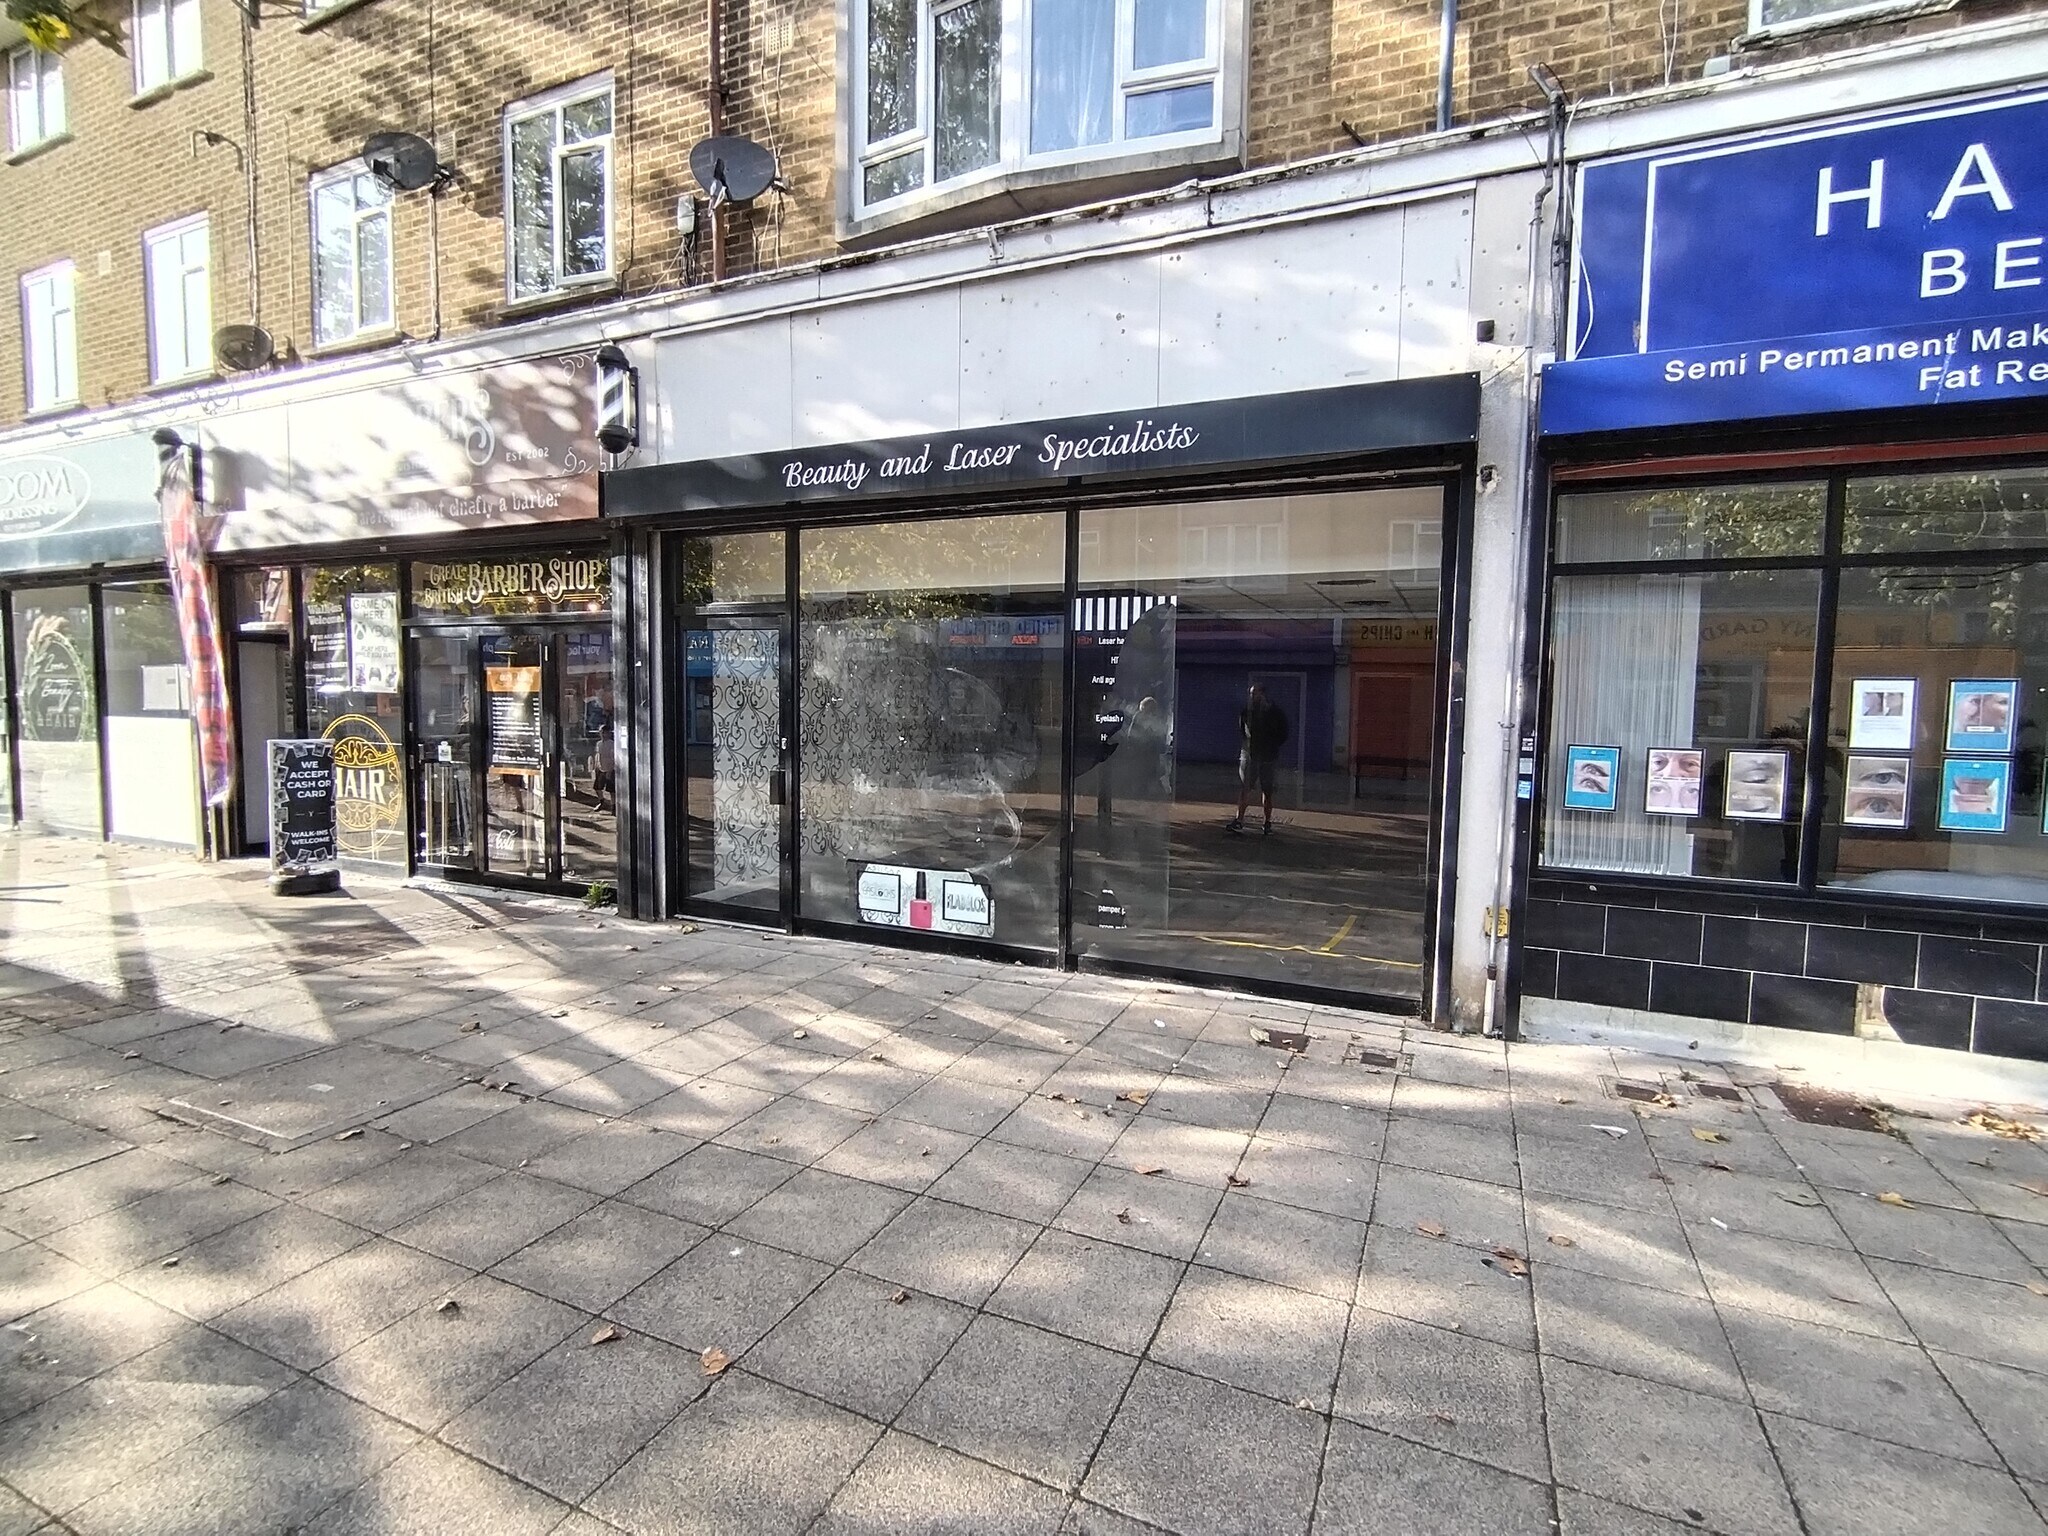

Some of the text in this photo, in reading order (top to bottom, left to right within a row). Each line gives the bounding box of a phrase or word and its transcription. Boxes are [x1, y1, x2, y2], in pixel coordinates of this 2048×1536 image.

[1664, 351, 1748, 382] Semi
[1760, 331, 1957, 373] Permanent
[1919, 364, 1982, 391] Fat
[506, 447, 550, 462] EST 2002
[782, 420, 1200, 490] Beauty and Laser Specialists
[499, 499, 508, 512] a
[467, 557, 602, 605] BARBER SHOP
[352, 598, 394, 609] GAME ON
[300, 760, 319, 770] WE
[289, 770, 329, 779] ACCEPT
[286, 779, 332, 789] CASH OR
[297, 789, 327, 799] CARD
[290, 829, 329, 839] WALK-INS
[290, 836, 331, 846] WELCOME
